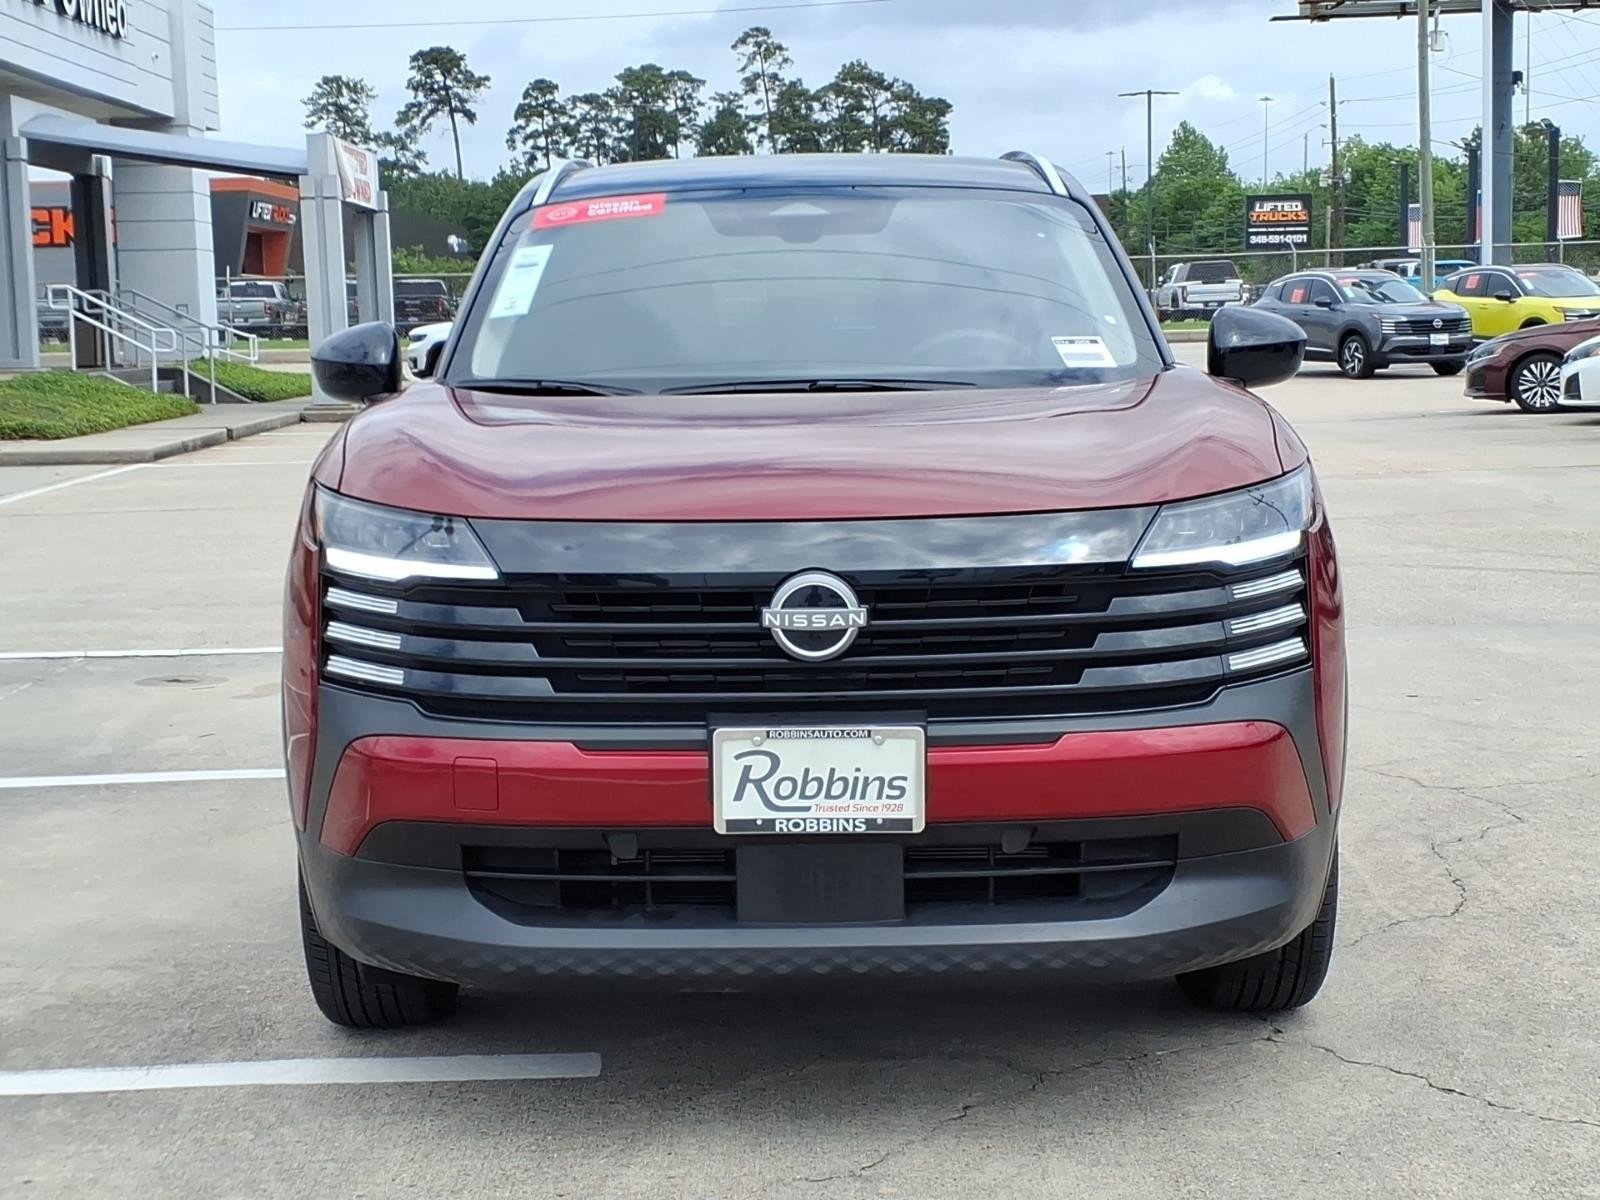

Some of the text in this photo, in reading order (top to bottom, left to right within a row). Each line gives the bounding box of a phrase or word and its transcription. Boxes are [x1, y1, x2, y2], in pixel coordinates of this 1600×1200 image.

[1255, 201, 1302, 212] LIFTED
[1250, 211, 1308, 222] TRUCKS
[764, 611, 865, 627] NISSAN
[769, 730, 868, 739] ROBBINSAUTO.COM
[733, 749, 908, 812] Robbins
[814, 803, 904, 813] Trusted Since 1928
[775, 818, 867, 832] ROBBINS
